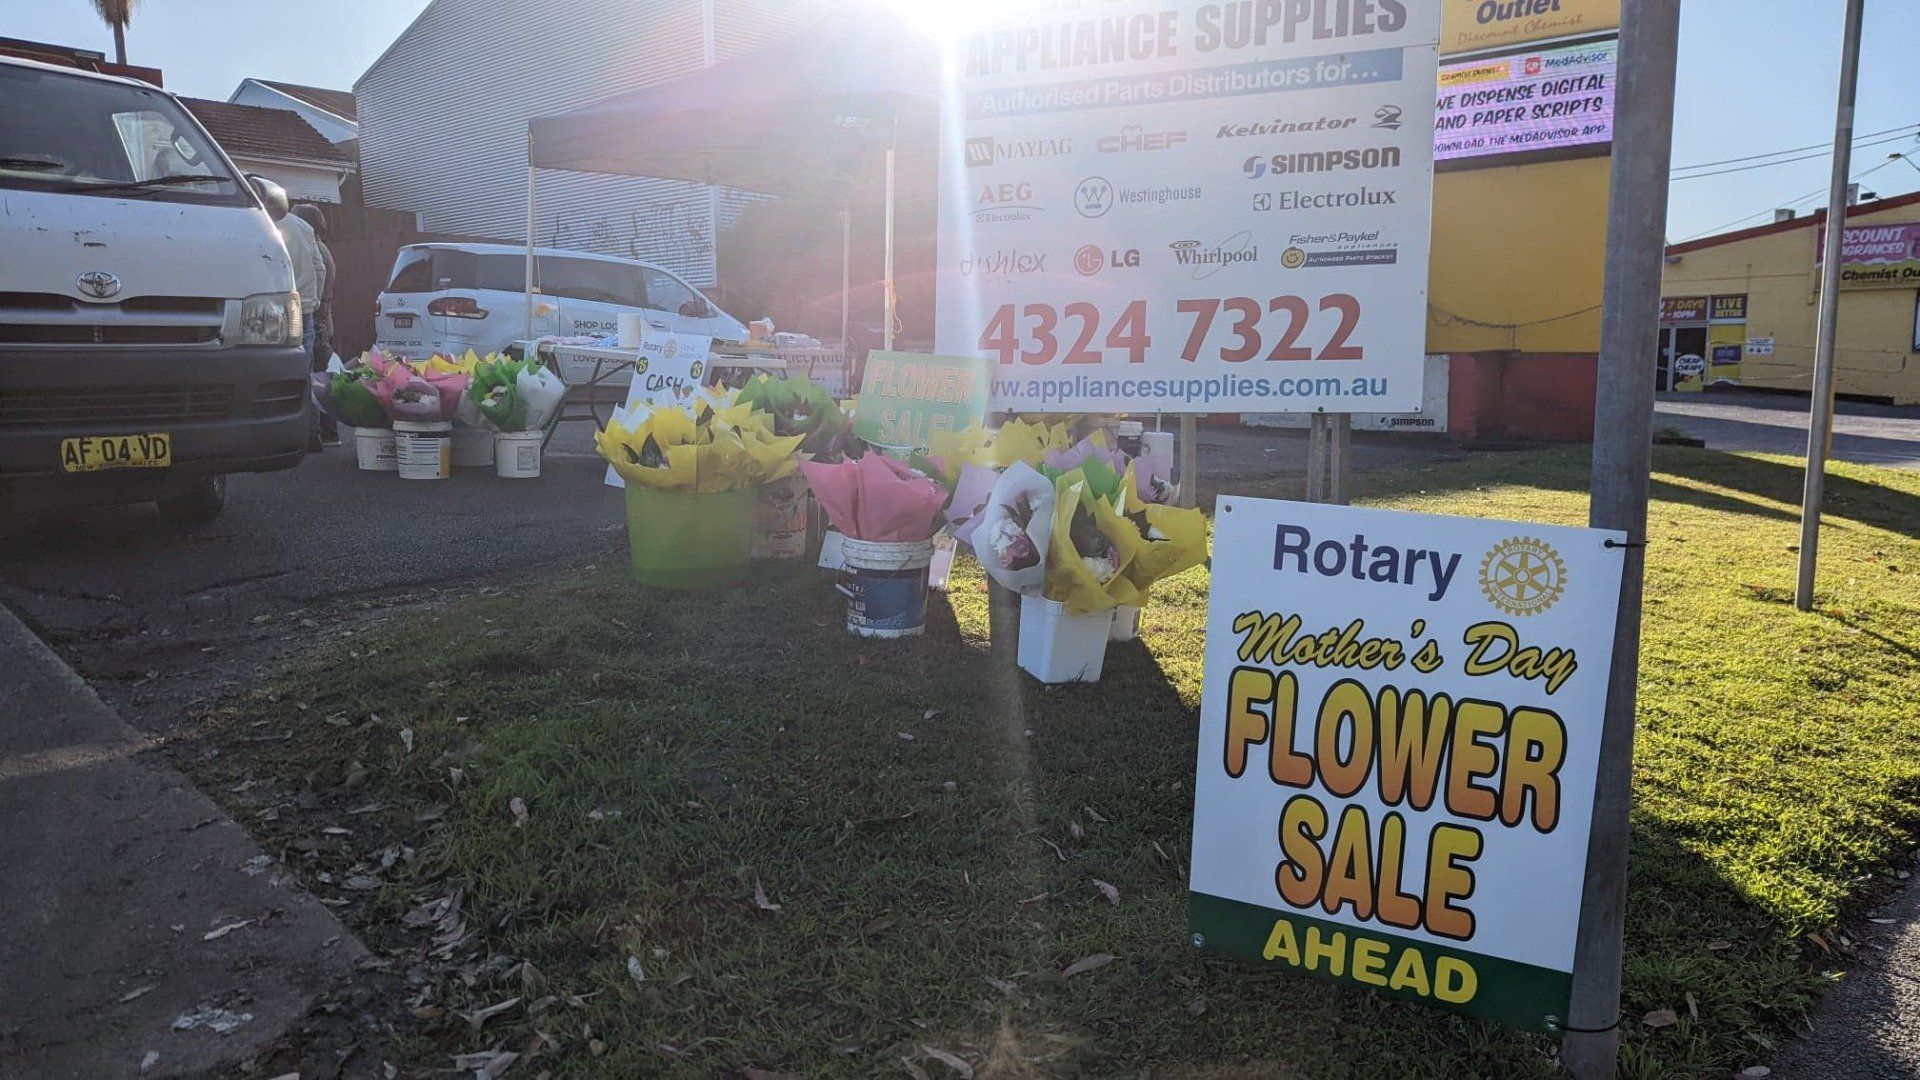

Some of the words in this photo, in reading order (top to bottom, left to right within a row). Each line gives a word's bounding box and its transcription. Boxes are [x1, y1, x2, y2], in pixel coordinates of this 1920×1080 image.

[1477, 0, 1560, 24] Outlet
[966, 11, 1178, 77] APPLIANCE
[1194, 0, 1407, 54] SUPPLIES
[1458, 25, 1519, 45] Discount
[1524, 14, 1583, 33] Chemist
[981, 81, 1099, 114] Authorised
[1105, 79, 1166, 102] Parts
[1170, 66, 1310, 98] Distributors
[1314, 59, 1379, 82] for...
[1461, 84, 1536, 107] DISPENSE
[1541, 74, 1605, 96] DIGITAL
[1216, 114, 1357, 139] Kelvinator
[1435, 114, 1467, 131] AND
[1472, 107, 1526, 127] PAPER
[1532, 97, 1604, 120] SCRIPTS
[1097, 129, 1188, 154] CHEF
[1489, 136, 1505, 147] THE
[1509, 127, 1578, 143] MEDADVISOR
[1582, 125, 1605, 136] APP
[995, 138, 1072, 160] MAYTAG
[1271, 146, 1401, 174] SIMPSON
[978, 182, 1033, 203] AEG
[1119, 186, 1202, 205] Westinghouse
[1279, 187, 1396, 210] Electrolux
[1111, 249, 1140, 268] LG
[1176, 246, 1258, 266] Whirlpool
[1842, 268, 1898, 281] Chemist
[1903, 267, 1920, 278] Ou
[1677, 299, 1705, 309] DAYS
[1715, 298, 1744, 309] LIVE
[573, 320, 598, 330] SHOP
[600, 321, 617, 331] LOC
[978, 300, 1151, 366] 4324
[1176, 293, 1363, 364] 7322
[643, 341, 663, 354] Rotary
[646, 373, 685, 391] CASH
[869, 360, 976, 405] FLOWER
[1273, 523, 1462, 602] Rotary
[1232, 610, 1443, 674] Mother's
[1463, 620, 1579, 694] Day
[1223, 665, 1568, 834] FLOWER
[1275, 794, 1484, 942] SALE
[1262, 918, 1479, 1005] AHEAD
